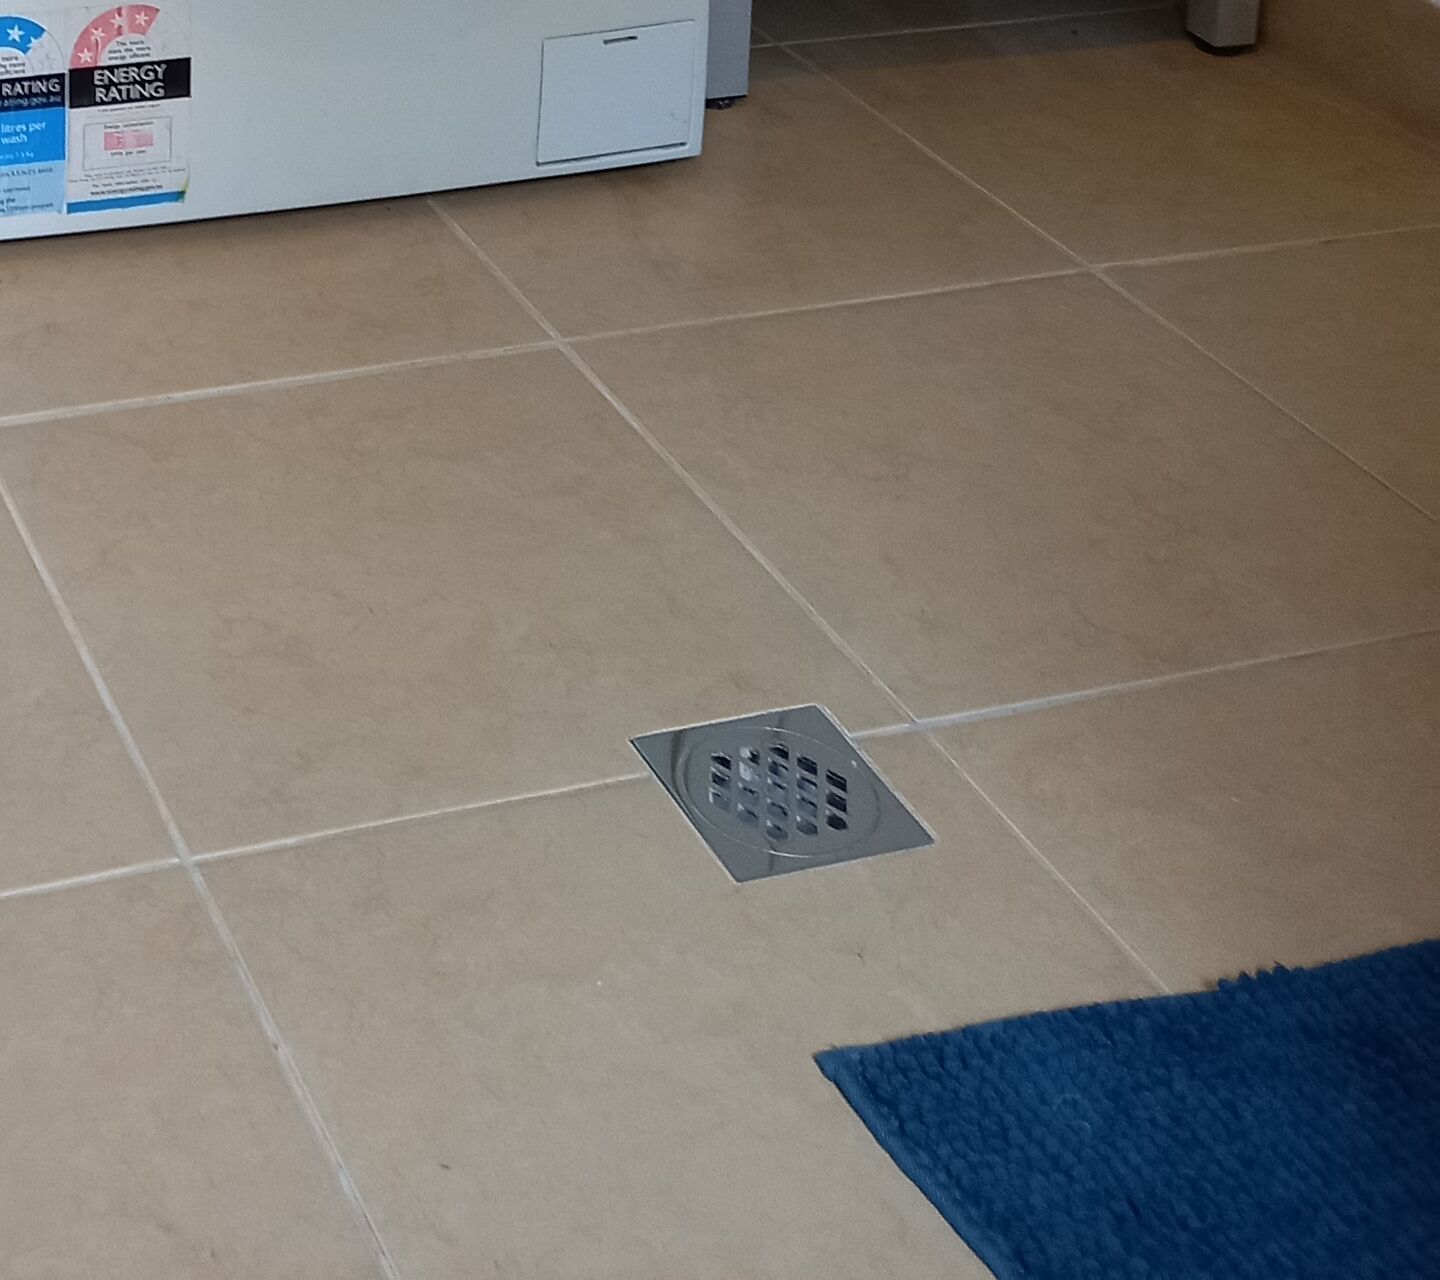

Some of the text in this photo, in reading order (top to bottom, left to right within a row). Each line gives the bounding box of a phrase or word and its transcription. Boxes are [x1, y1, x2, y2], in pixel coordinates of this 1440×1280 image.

[93, 62, 167, 86] ENERGY
[1, 77, 61, 97] RATING
[95, 81, 166, 103] RATING
[1, 123, 27, 134] litres
[28, 121, 47, 133] per
[0, 133, 28, 145] wash
